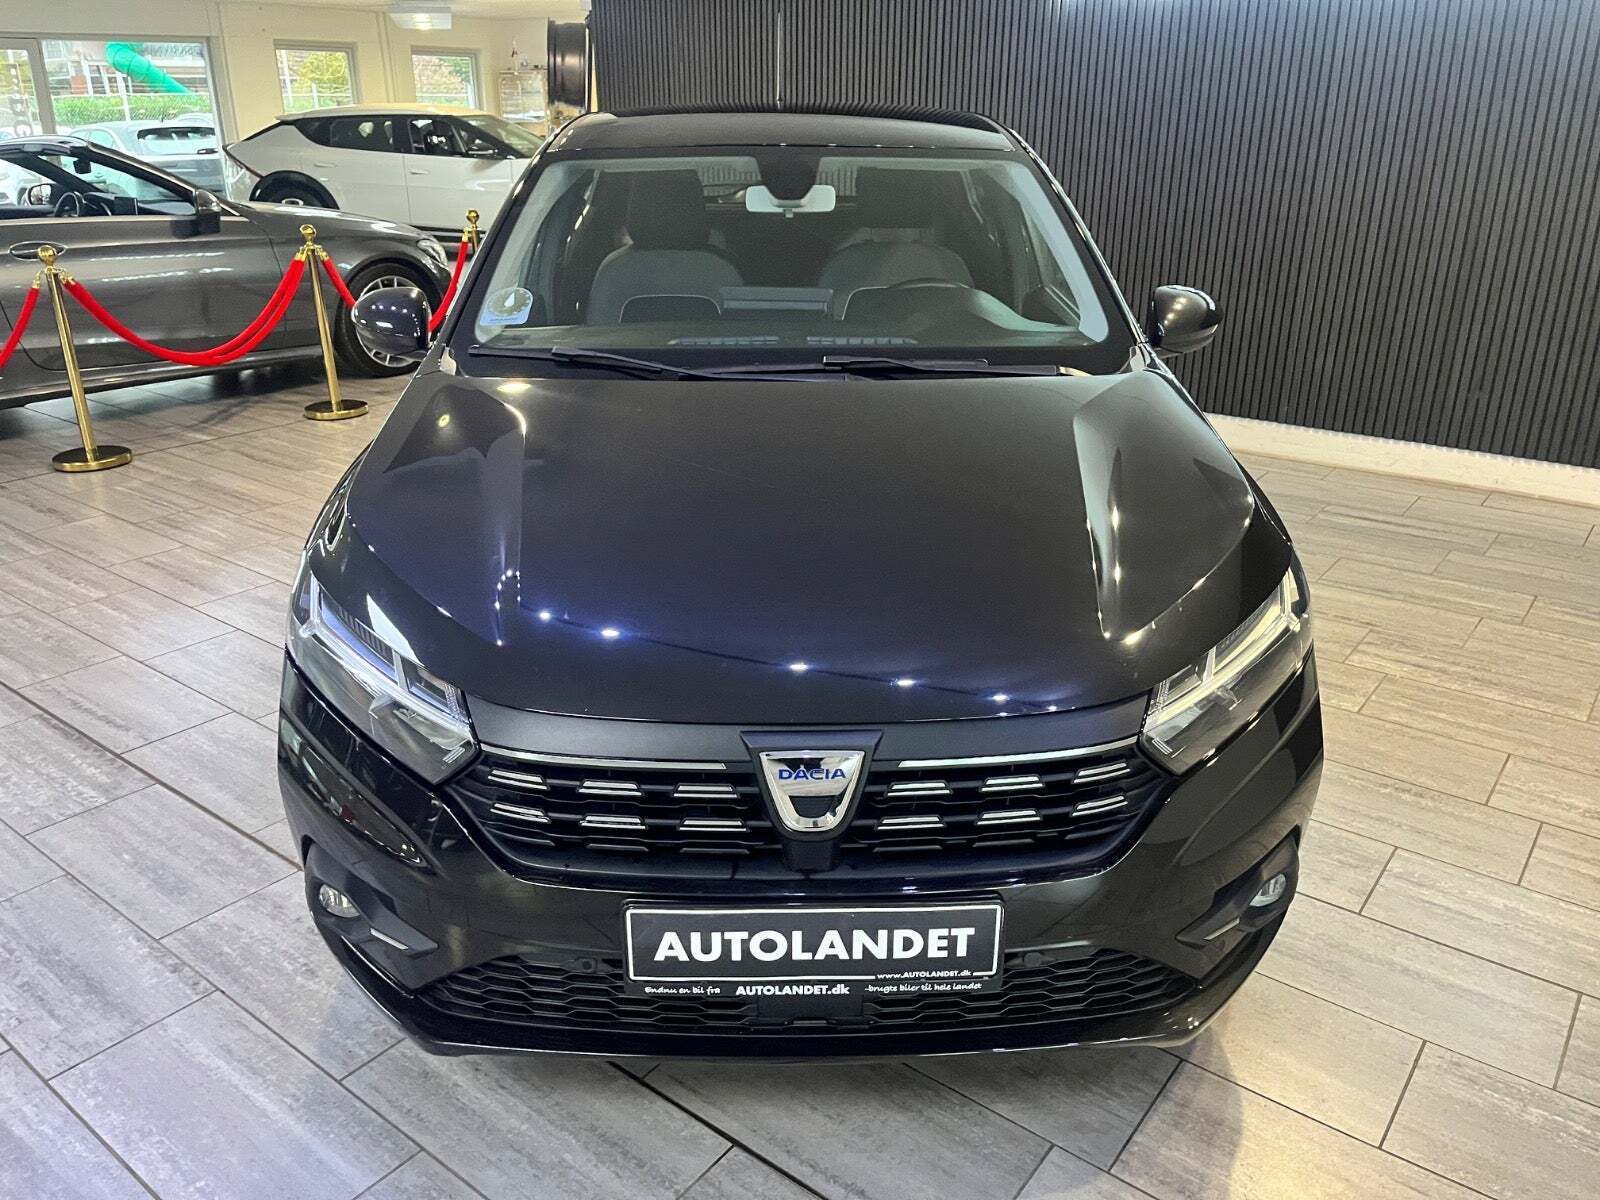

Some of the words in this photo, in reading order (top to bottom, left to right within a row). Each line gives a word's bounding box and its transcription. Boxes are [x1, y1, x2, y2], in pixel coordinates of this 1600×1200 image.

[778, 768, 846, 780] DACIA
[653, 927, 976, 962] AUTOLANDET
[876, 969, 972, 979] www.AUTOLANDET.dk
[644, 986, 678, 994] Endnu
[678, 986, 691, 994] en
[692, 985, 705, 994] bil
[706, 985, 721, 996] fra
[735, 983, 850, 996] AUTOLANDET.dk
[899, 983, 920, 991] biler
[920, 983, 933, 991] til
[933, 982, 951, 991] hele
[952, 982, 982, 991] landet
